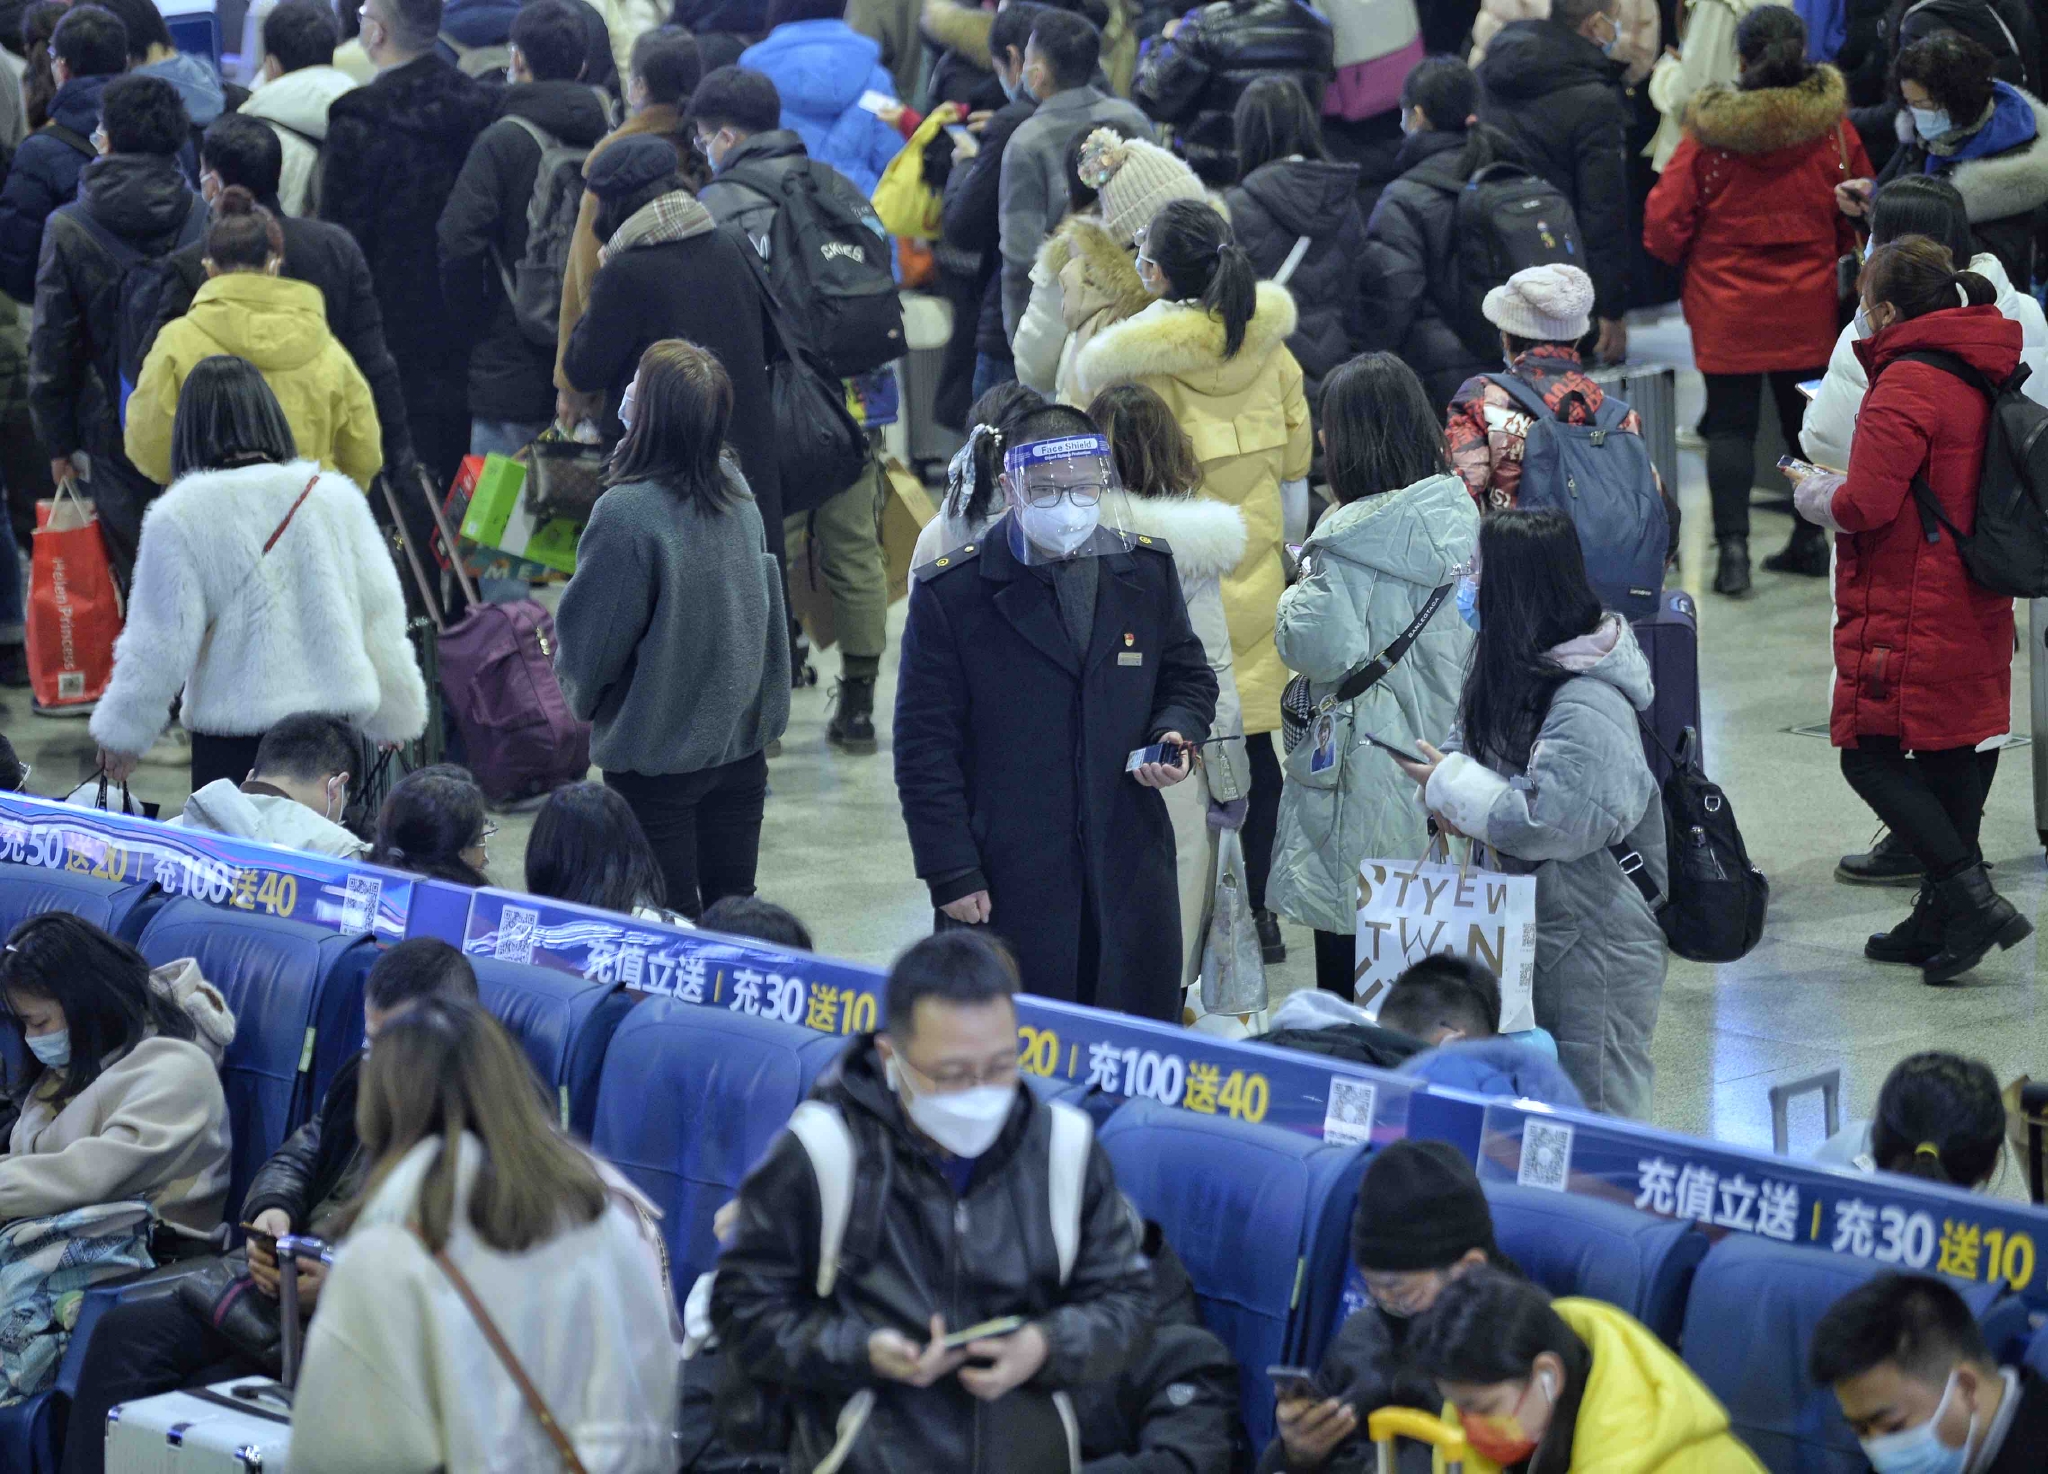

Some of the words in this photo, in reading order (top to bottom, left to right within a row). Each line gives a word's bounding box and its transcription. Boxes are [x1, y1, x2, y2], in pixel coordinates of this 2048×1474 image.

[1041, 444, 1063, 455] Face
[1065, 440, 1092, 451] Shield
[52, 557, 68, 605] Helen
[58, 604, 76, 671] Princess
[583, 941, 707, 1004] 充值立送
[729, 969, 877, 1035] 充30送10
[1085, 1040, 1269, 1124] 充100送40
[1634, 1157, 1801, 1241] 充值立送
[1832, 1198, 2036, 1291] 充30送10
